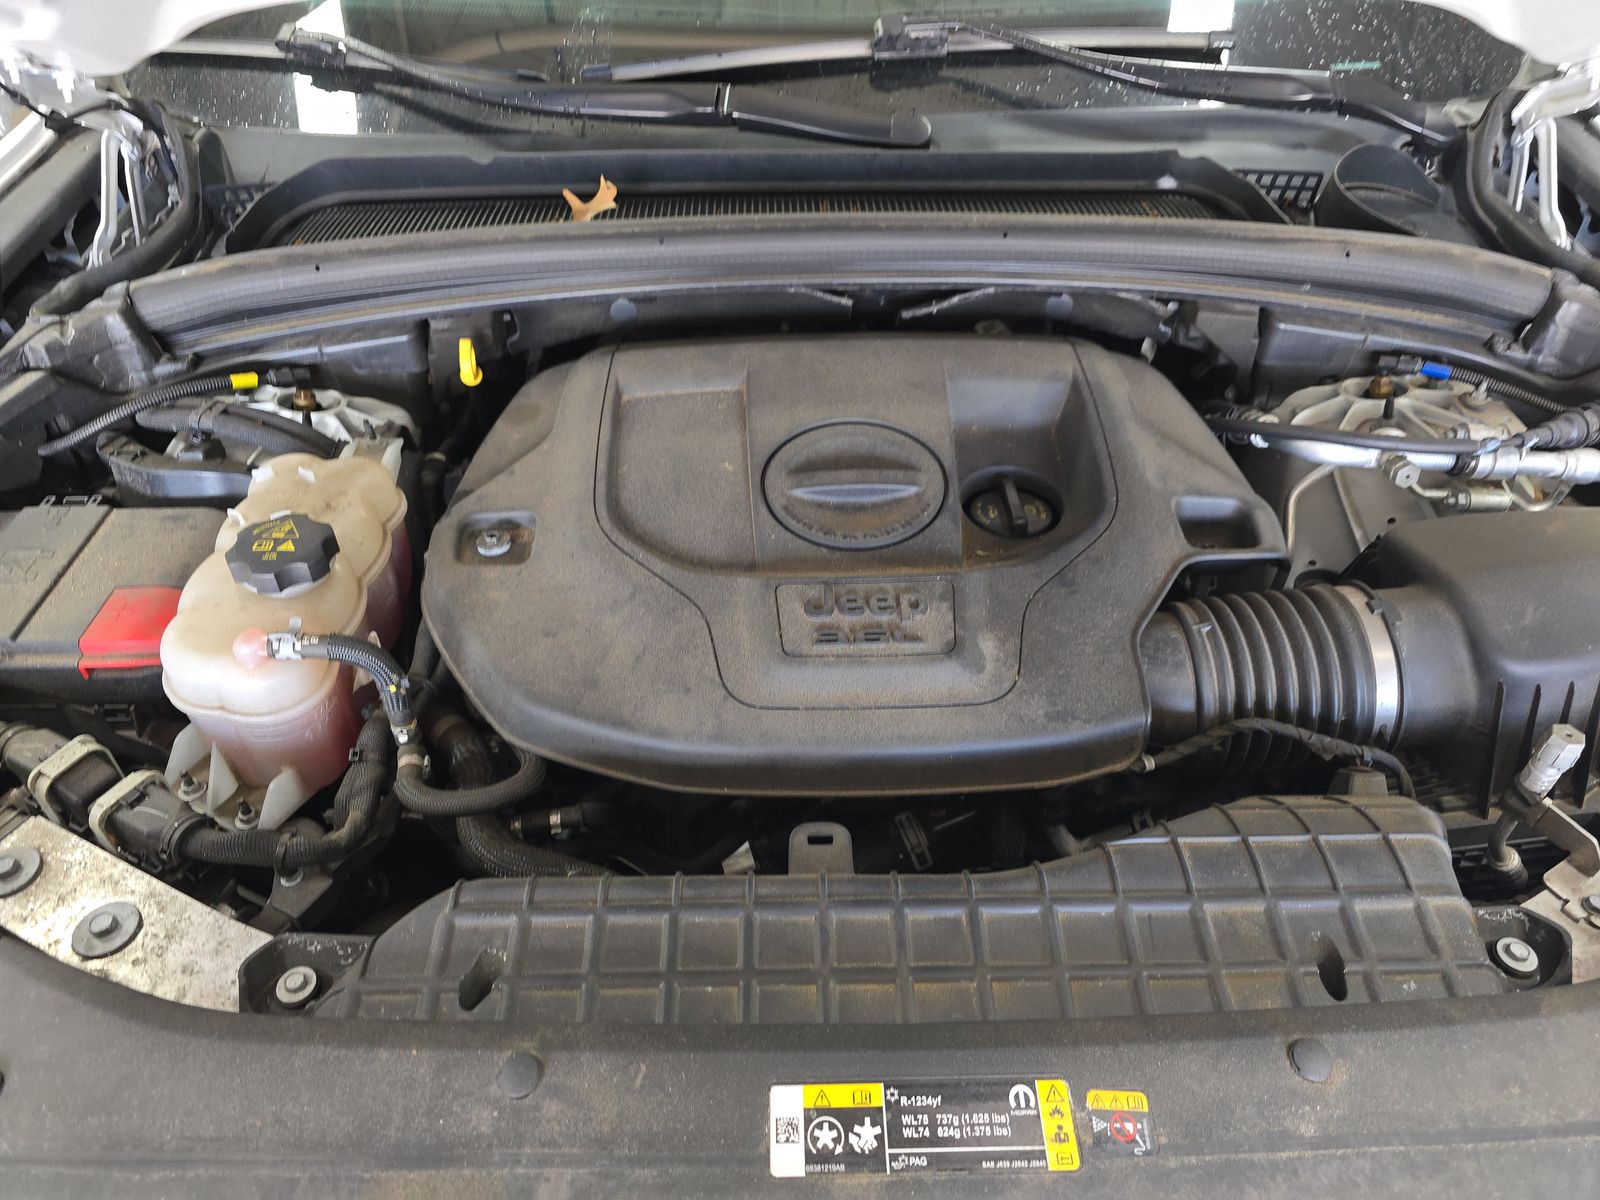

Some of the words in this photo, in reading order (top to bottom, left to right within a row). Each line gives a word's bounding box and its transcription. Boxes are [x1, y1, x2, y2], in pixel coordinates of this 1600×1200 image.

[803, 583, 929, 624] Jeep
[900, 1095, 941, 1108] R-1234yf
[901, 1114, 929, 1125] WL75
[936, 1114, 959, 1127] 737g
[961, 1113, 991, 1125] (1.625
[992, 1112, 1010, 1124] lbs)
[902, 1126, 930, 1138] WL74
[937, 1126, 961, 1139] 624g
[963, 1126, 992, 1138] (1.375
[993, 1125, 1011, 1137] lbs)
[909, 1156, 928, 1167] PAG
